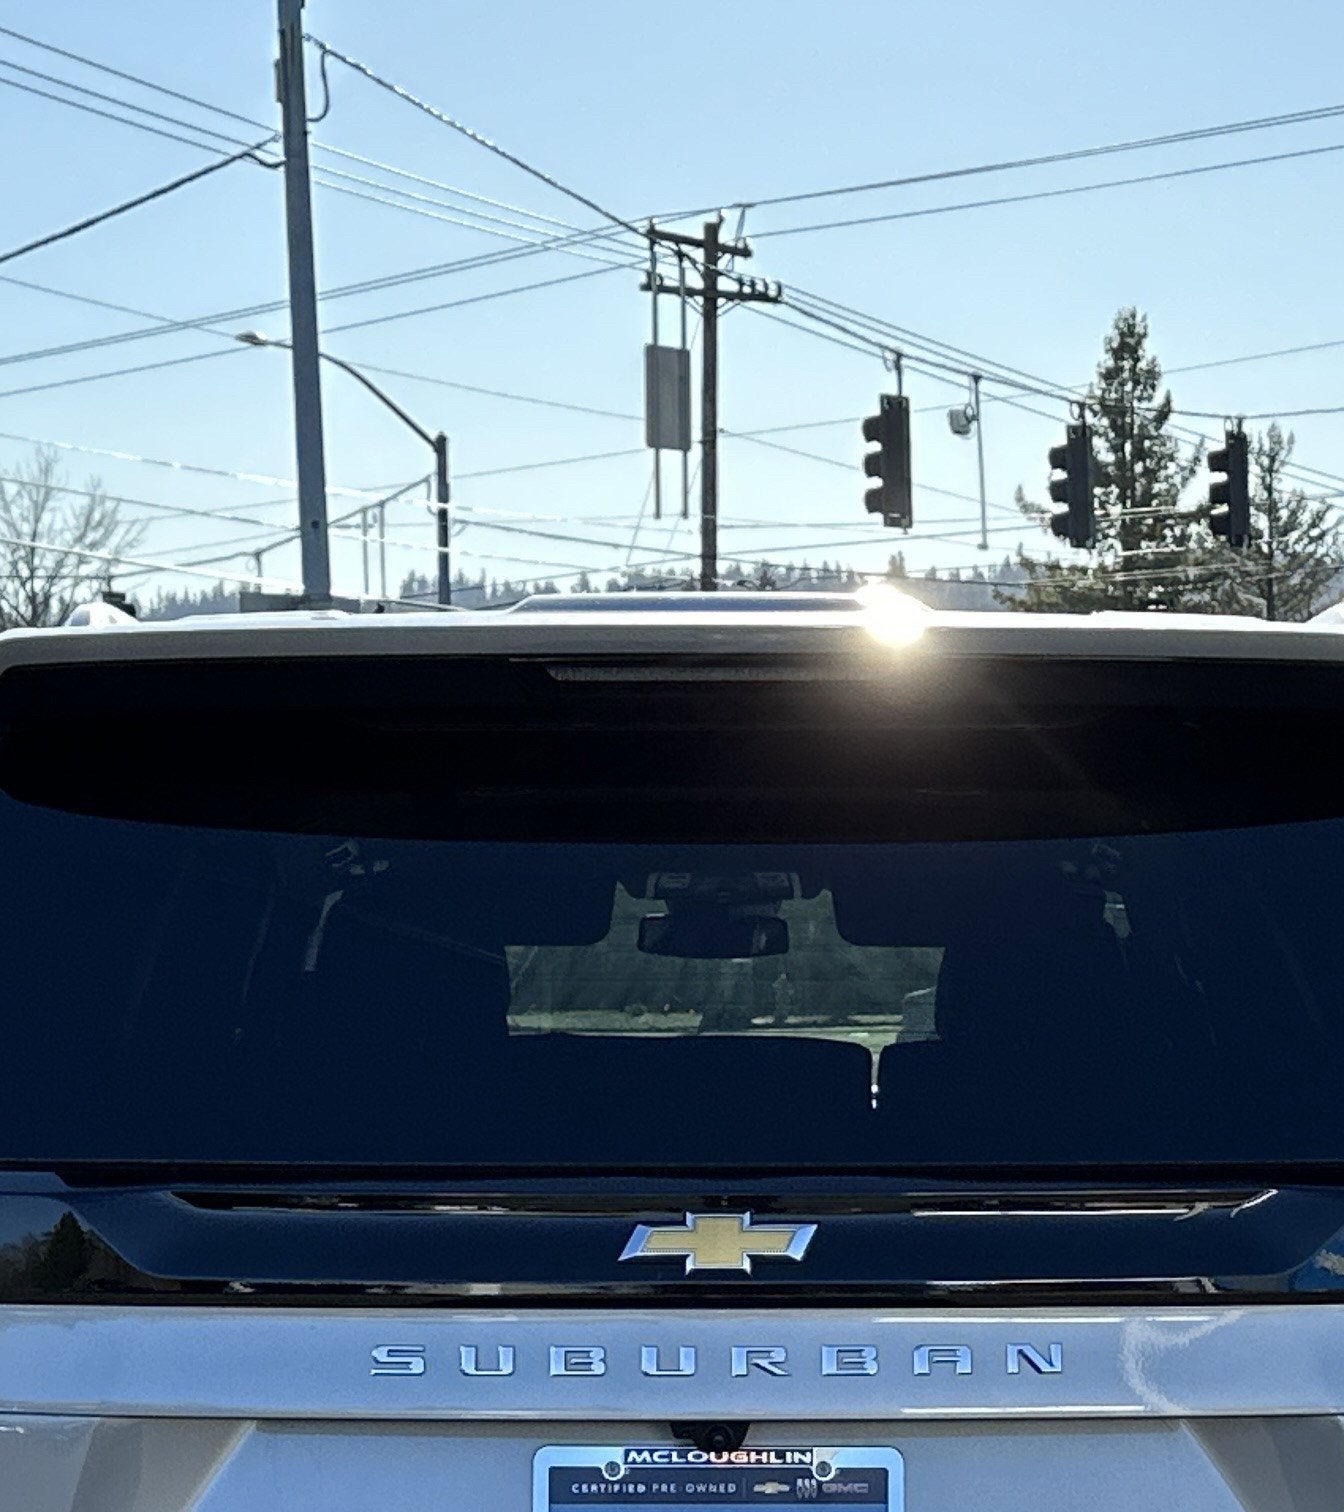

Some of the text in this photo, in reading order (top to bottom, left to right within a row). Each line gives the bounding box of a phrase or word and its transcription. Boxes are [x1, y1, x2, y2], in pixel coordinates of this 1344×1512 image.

[370, 1343, 1064, 1378] SUBURBAN
[627, 1450, 812, 1464] MCLOUGHLIN
[571, 1483, 737, 1494] CERTIFIED PRE OWNED
[821, 1483, 869, 1494] GMC
